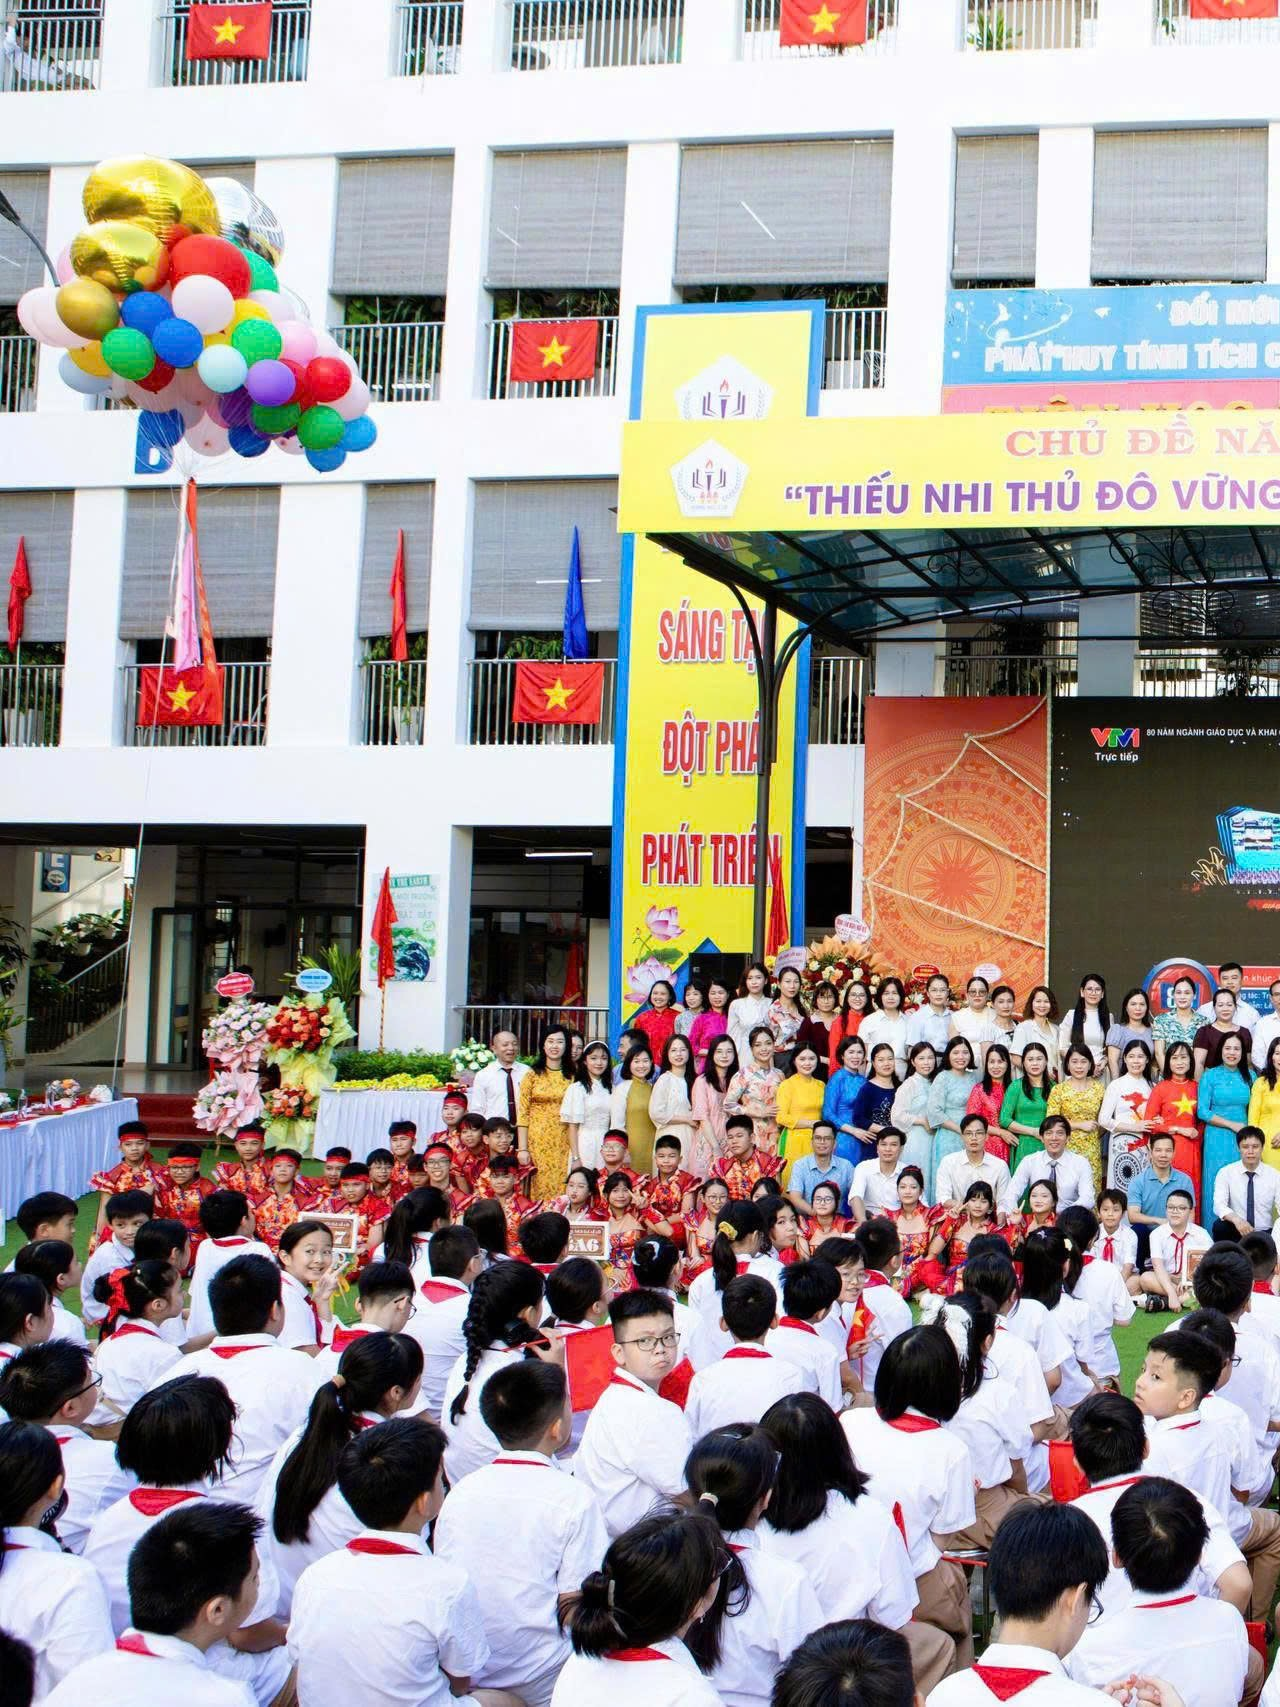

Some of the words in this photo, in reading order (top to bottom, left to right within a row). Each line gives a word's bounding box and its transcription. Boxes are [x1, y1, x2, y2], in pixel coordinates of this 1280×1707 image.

[1124, 339, 1188, 370] TÍNH
[1195, 338, 1258, 369] TÍCH
[1006, 419, 1107, 457] CHỦ
[1128, 413, 1195, 455] ĐỀ
[922, 483, 992, 513] NHI
[1006, 470, 1081, 512] THỦ
[1095, 472, 1157, 511] ĐÔ
[659, 600, 724, 661] SÁNG
[732, 609, 766, 671] TẠ
[663, 710, 709, 784] ĐỘT
[1157, 727, 1175, 736] NĂM
[1176, 727, 1204, 736] NGÀNH
[1206, 727, 1226, 736] GIÁO
[1227, 729, 1244, 738] DỤC
[1246, 727, 1257, 736] VÀ
[1095, 752, 1118, 763] Trực
[1120, 751, 1138, 763] tiếp
[642, 823, 703, 884] PHÁT
[570, 1239, 599, 1252] A6
